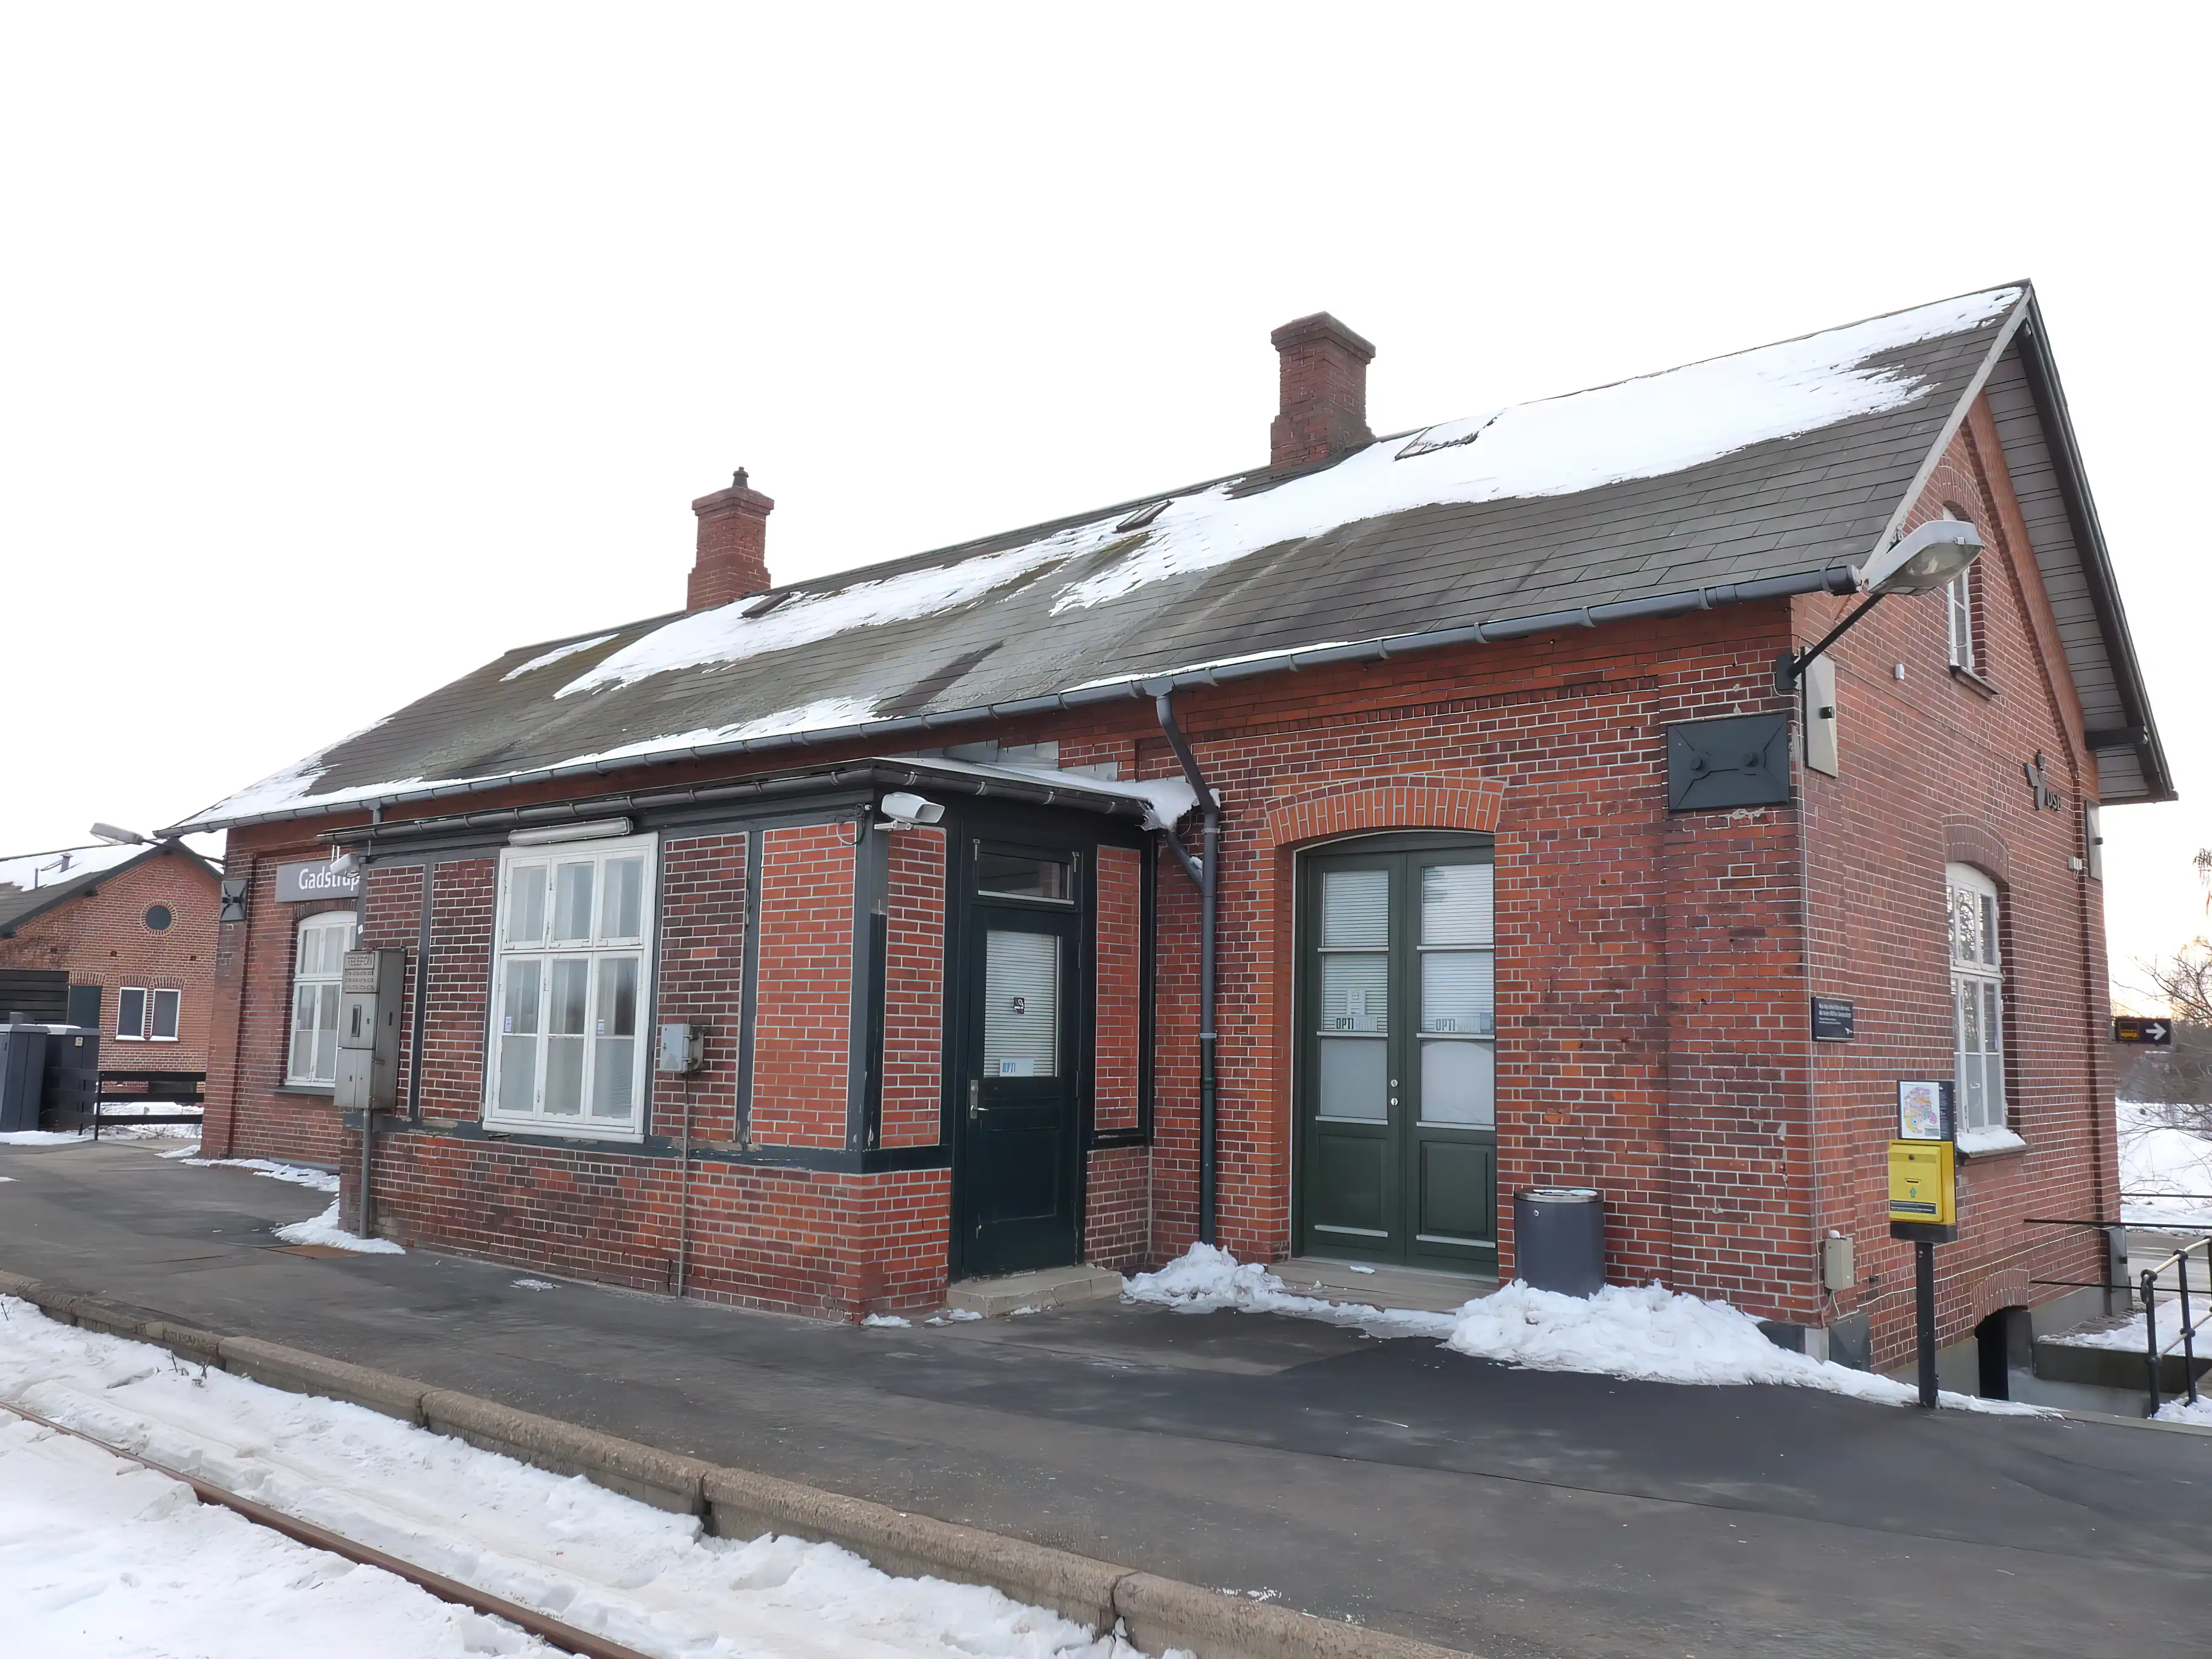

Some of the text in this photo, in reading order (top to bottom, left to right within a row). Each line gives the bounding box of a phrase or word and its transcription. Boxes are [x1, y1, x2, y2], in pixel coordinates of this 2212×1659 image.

[2045, 788, 2061, 811] DSB
[298, 866, 360, 891] Gadstrup
[347, 956, 372, 966] TELEFON
